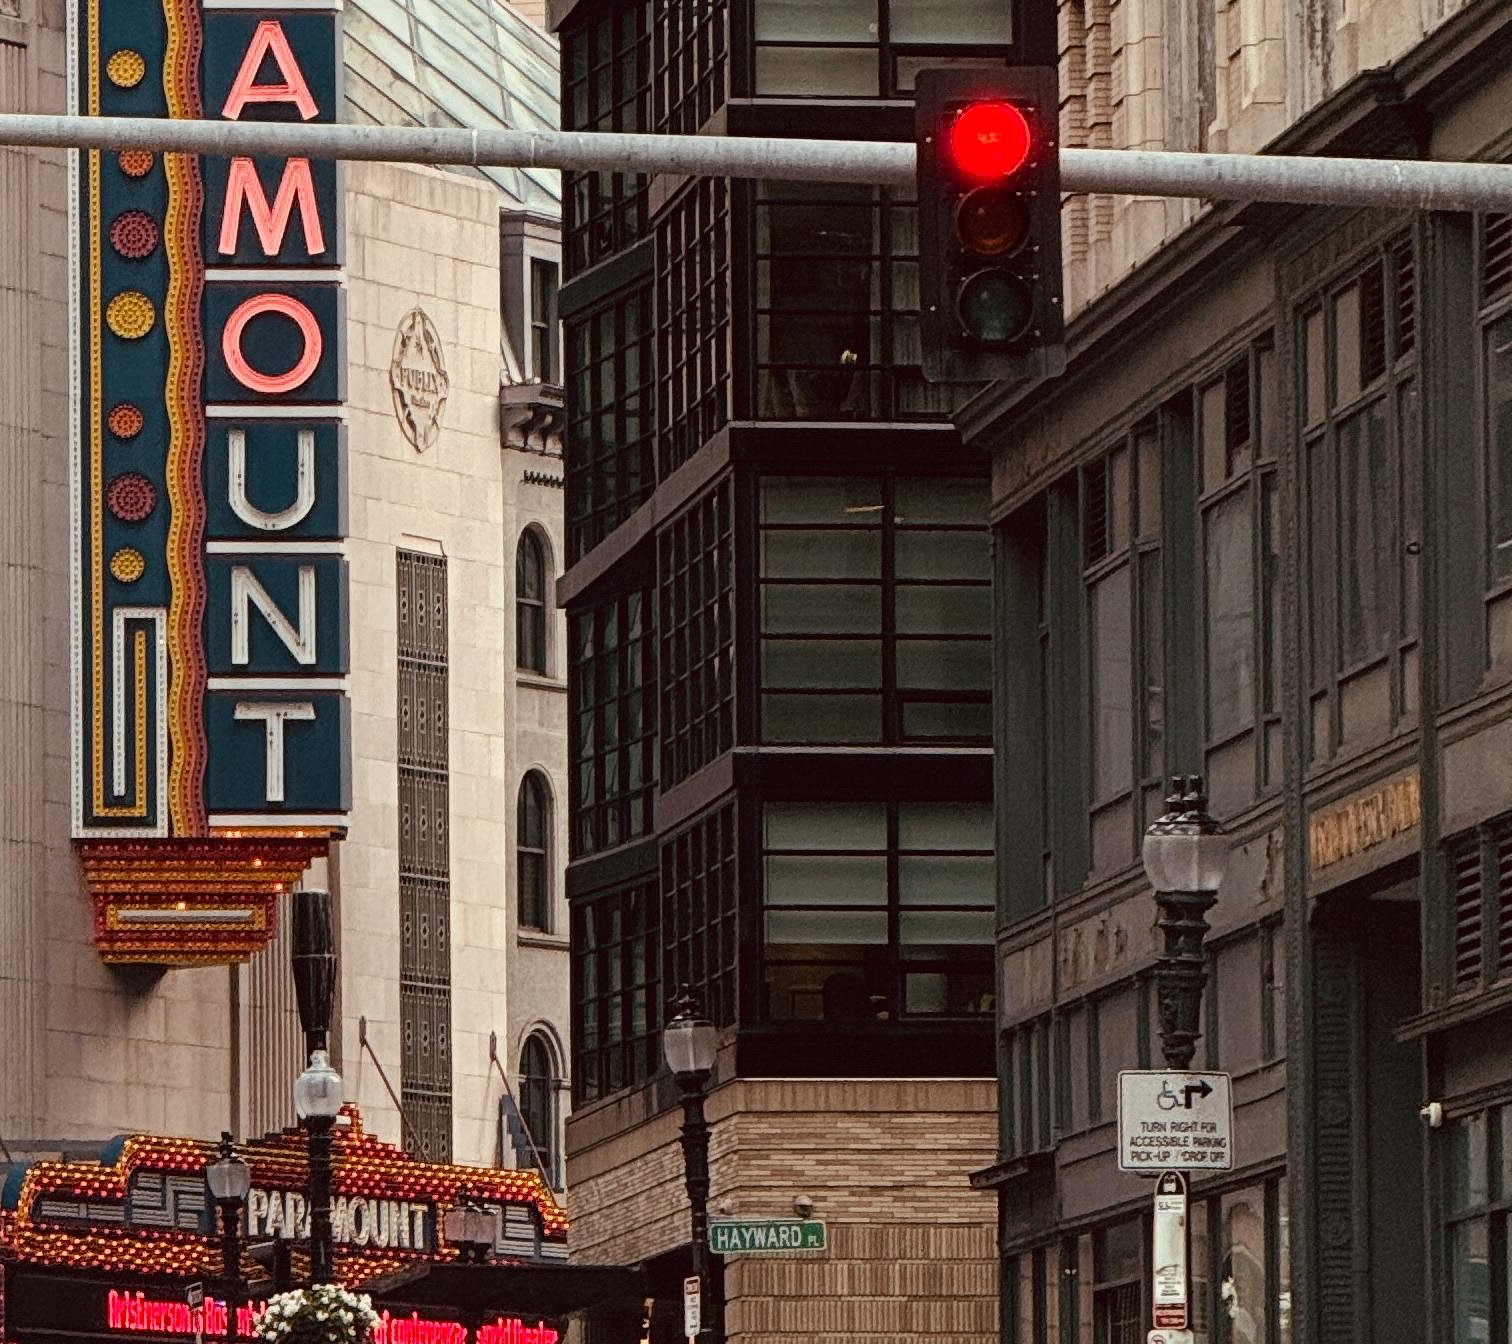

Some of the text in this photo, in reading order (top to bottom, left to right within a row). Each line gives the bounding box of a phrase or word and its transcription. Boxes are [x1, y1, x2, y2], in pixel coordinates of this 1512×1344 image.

[1140, 1121, 1166, 1133] TURN
[1170, 1121, 1198, 1133] RIGHT
[1130, 1136, 1190, 1148] ACCESSIBLE
[717, 1225, 819, 1249] HAYWARD PL
